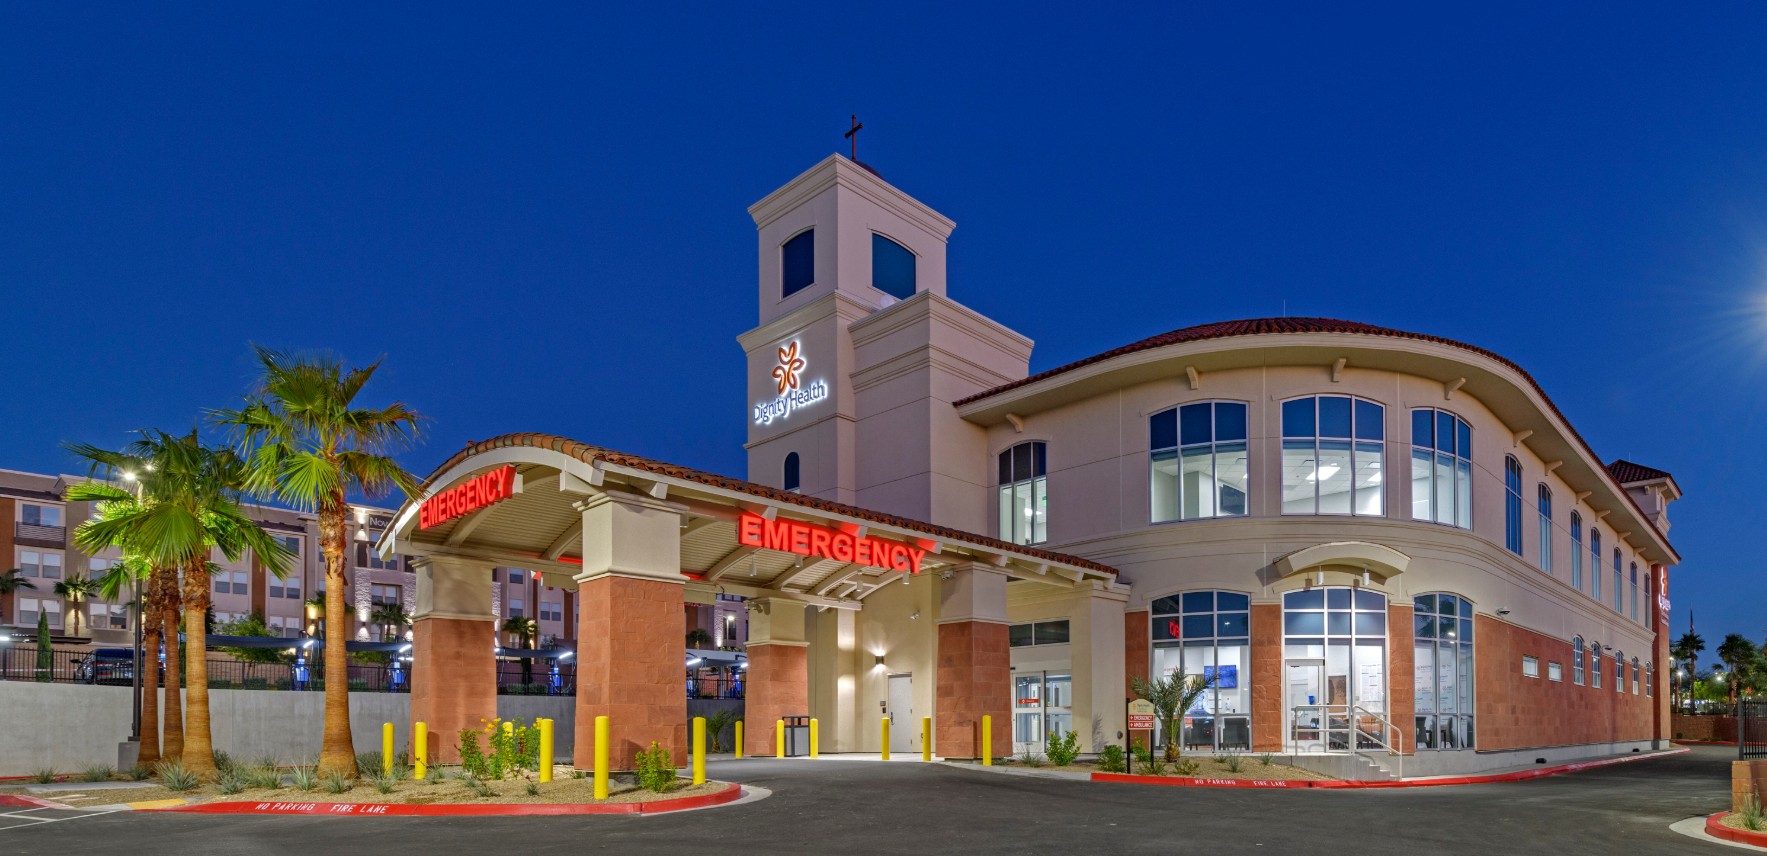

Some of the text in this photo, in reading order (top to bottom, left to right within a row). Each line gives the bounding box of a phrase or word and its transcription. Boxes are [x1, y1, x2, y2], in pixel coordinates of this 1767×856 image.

[754, 380, 826, 423] Dignity Health
[419, 465, 510, 530] EMERGENCY
[740, 513, 924, 574] EMERGENCY
[255, 802, 390, 814] NO PARKING FIRE LANE
